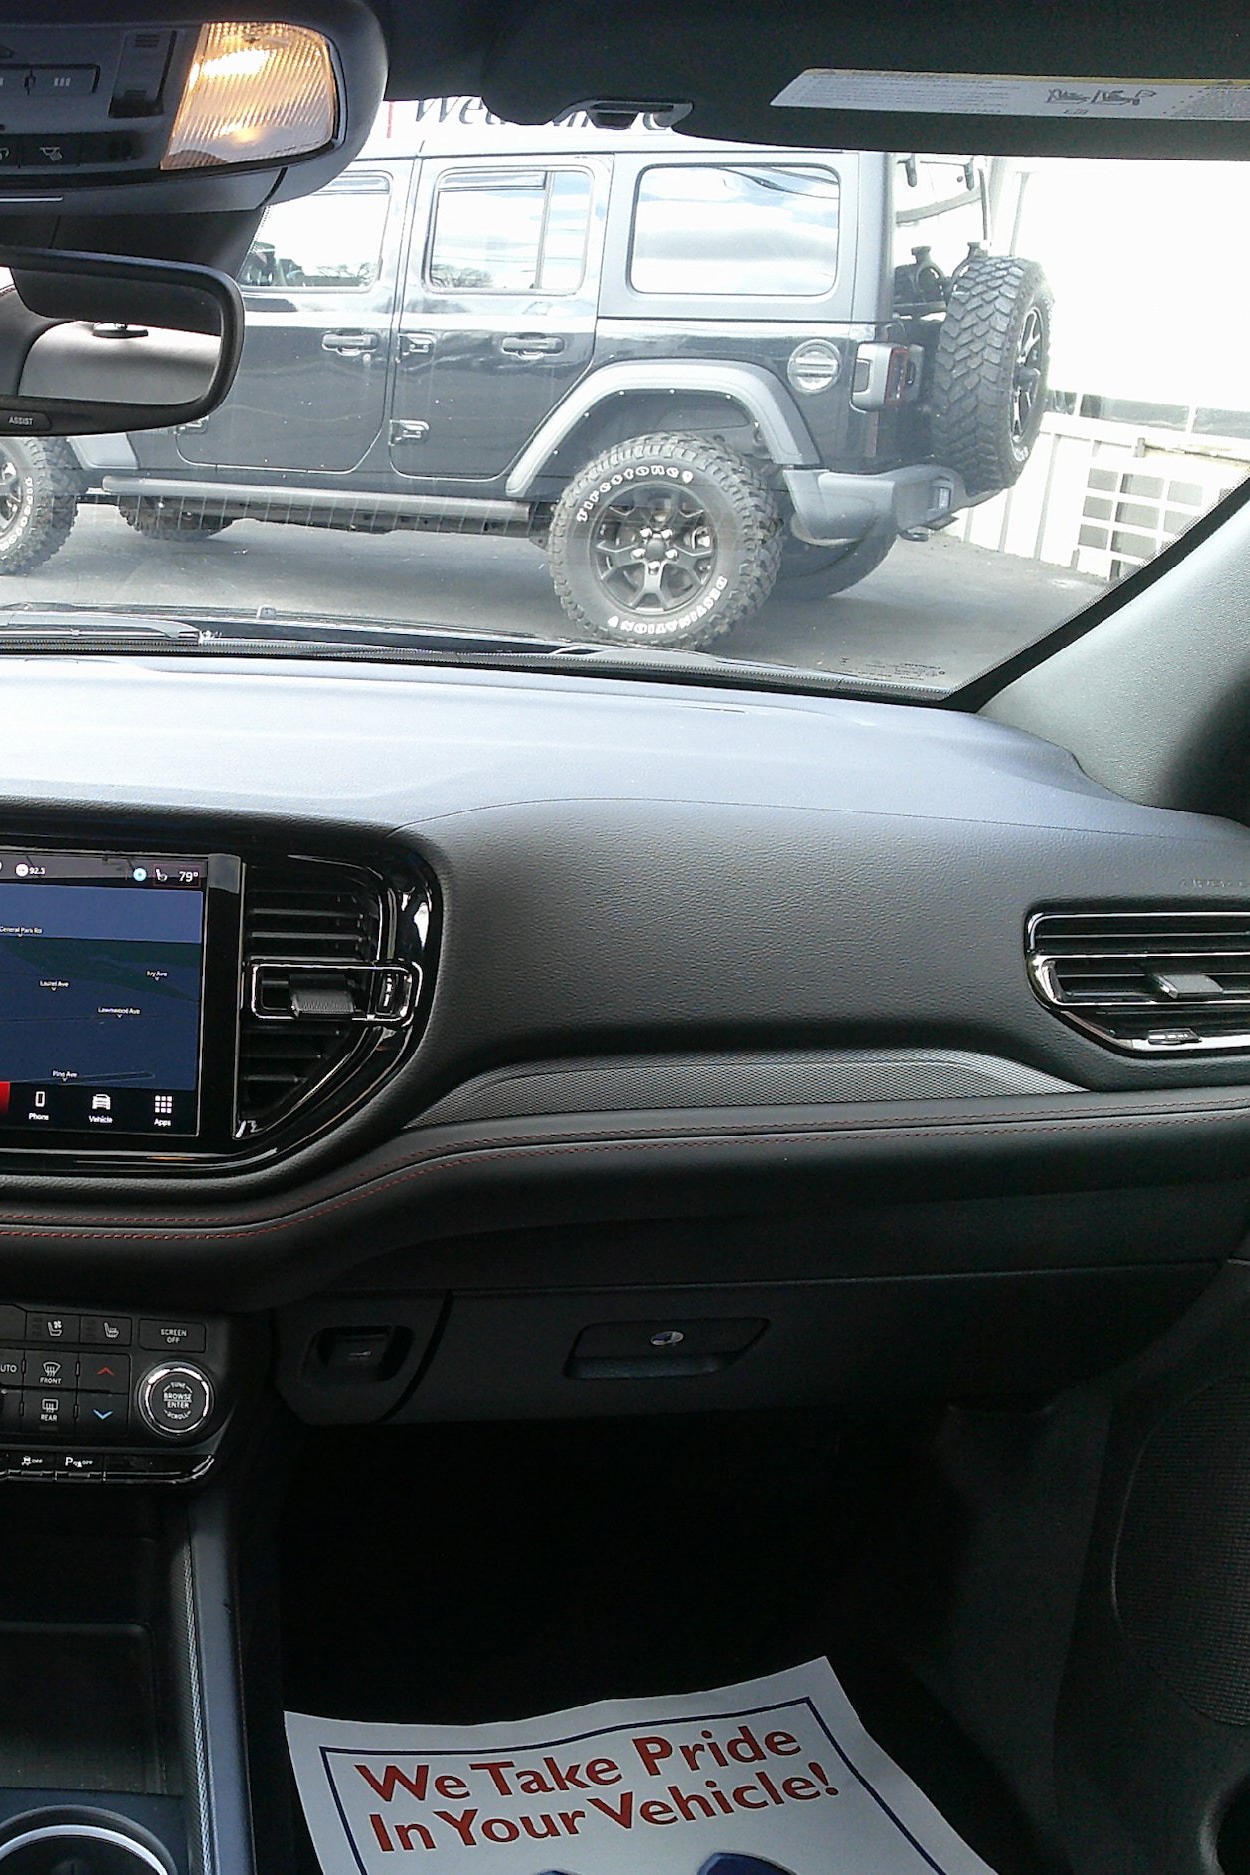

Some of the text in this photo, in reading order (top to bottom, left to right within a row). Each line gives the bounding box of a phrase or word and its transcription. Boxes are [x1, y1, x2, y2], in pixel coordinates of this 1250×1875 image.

[8, 416, 33, 425] ASSIST
[576, 464, 679, 523] Firestone
[618, 575, 728, 635] DESTINATION
[178, 871, 199, 882] 79°
[88, 1115, 113, 1124] Vehicle
[154, 1119, 172, 1127] Apps
[160, 1328, 187, 1336] SCREEN
[166, 1336, 181, 1344] OFF
[163, 1392, 192, 1400] BROWSE
[167, 1401, 189, 1409] ENTER
[354, 1725, 801, 1802] We Take Pride
[369, 1761, 840, 1852] In Your Vehicle!
